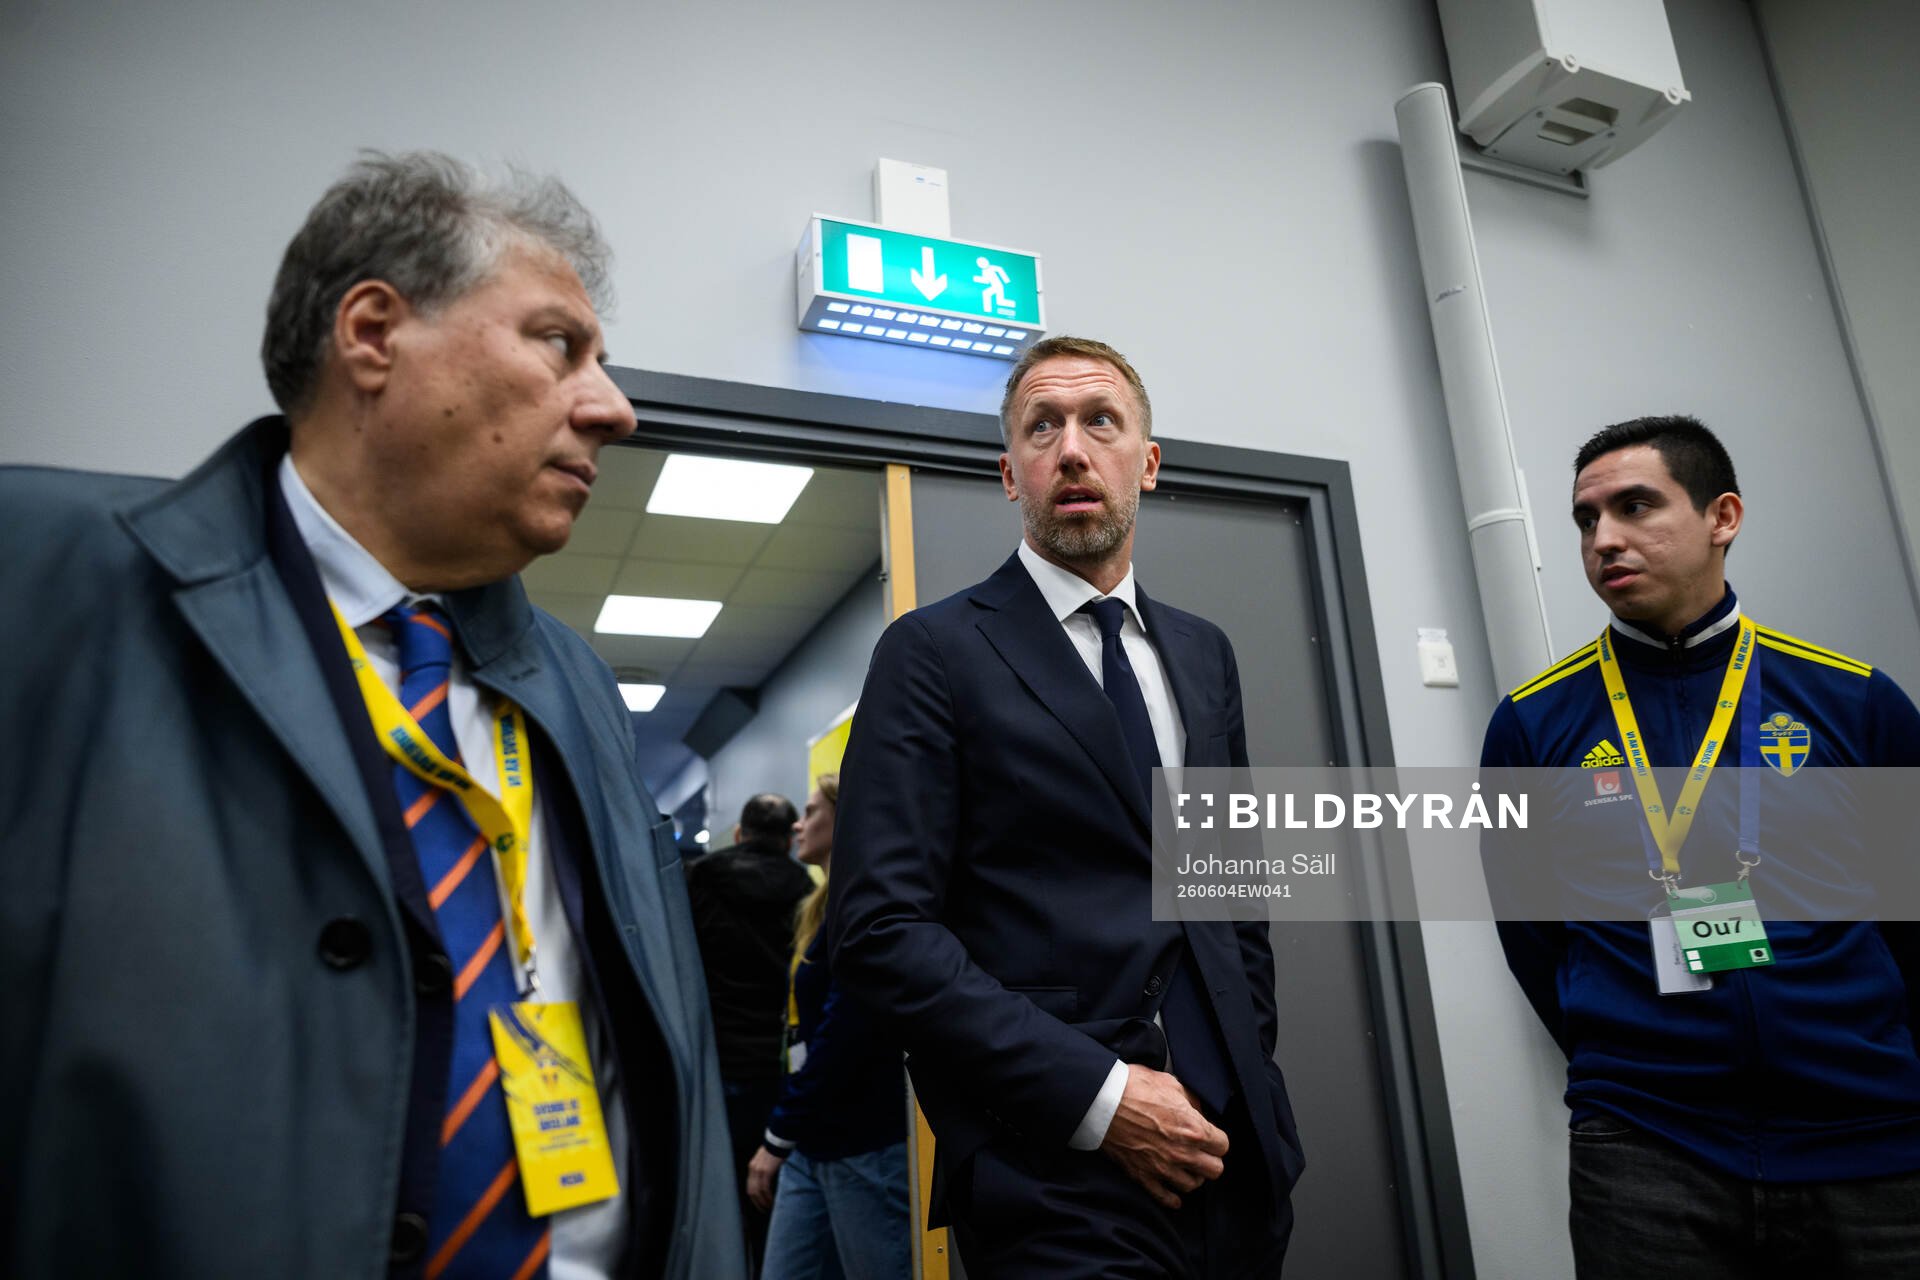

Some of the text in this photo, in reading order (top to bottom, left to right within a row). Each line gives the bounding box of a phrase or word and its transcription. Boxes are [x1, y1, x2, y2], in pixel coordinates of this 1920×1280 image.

[1581, 756, 1625, 768] adidas
[1584, 796, 1618, 807] SVENSKA
[1692, 916, 1742, 938] Ou7
